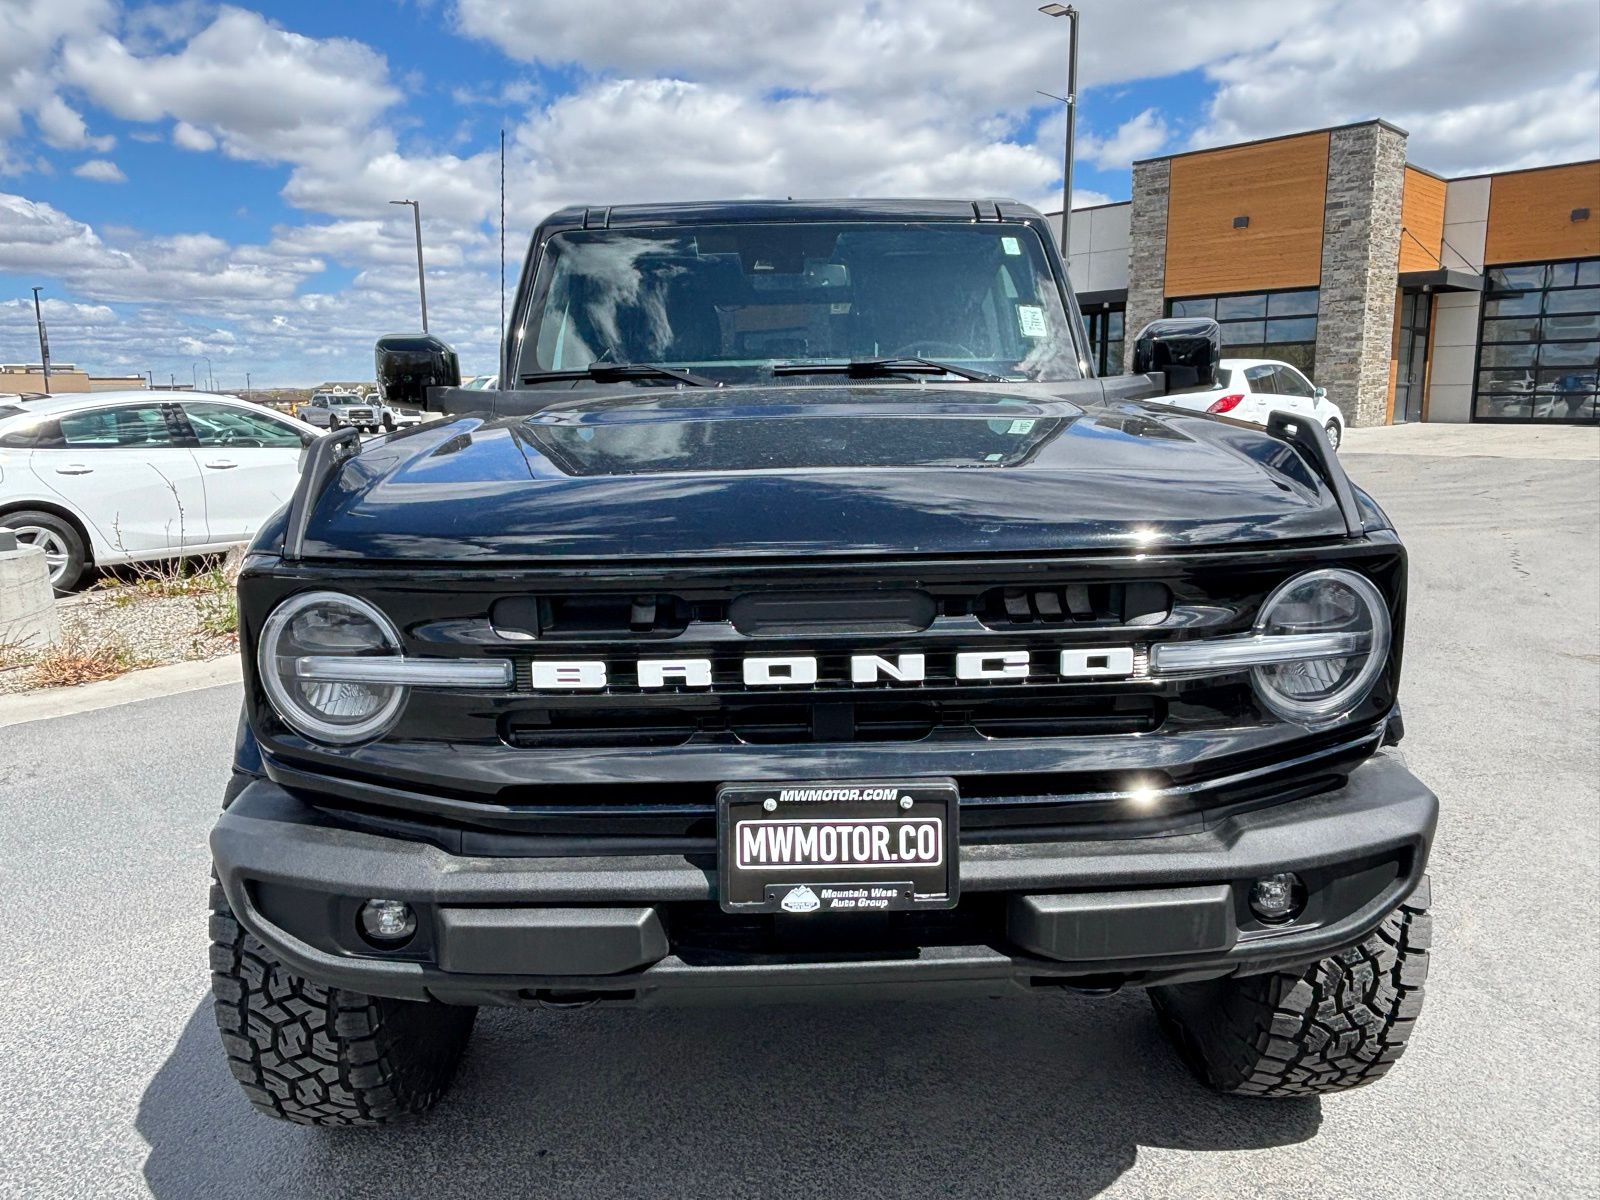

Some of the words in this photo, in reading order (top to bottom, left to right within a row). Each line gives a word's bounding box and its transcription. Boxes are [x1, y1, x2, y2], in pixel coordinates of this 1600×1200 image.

[531, 647, 1134, 689] BRONCO
[780, 789, 898, 801] MWMOTOR.COM
[743, 825, 936, 862] MWMOTOR.CO
[821, 888, 869, 899] Mountain
[871, 888, 898, 898] West
[830, 898, 855, 908] Auto
[857, 897, 889, 909] Group
